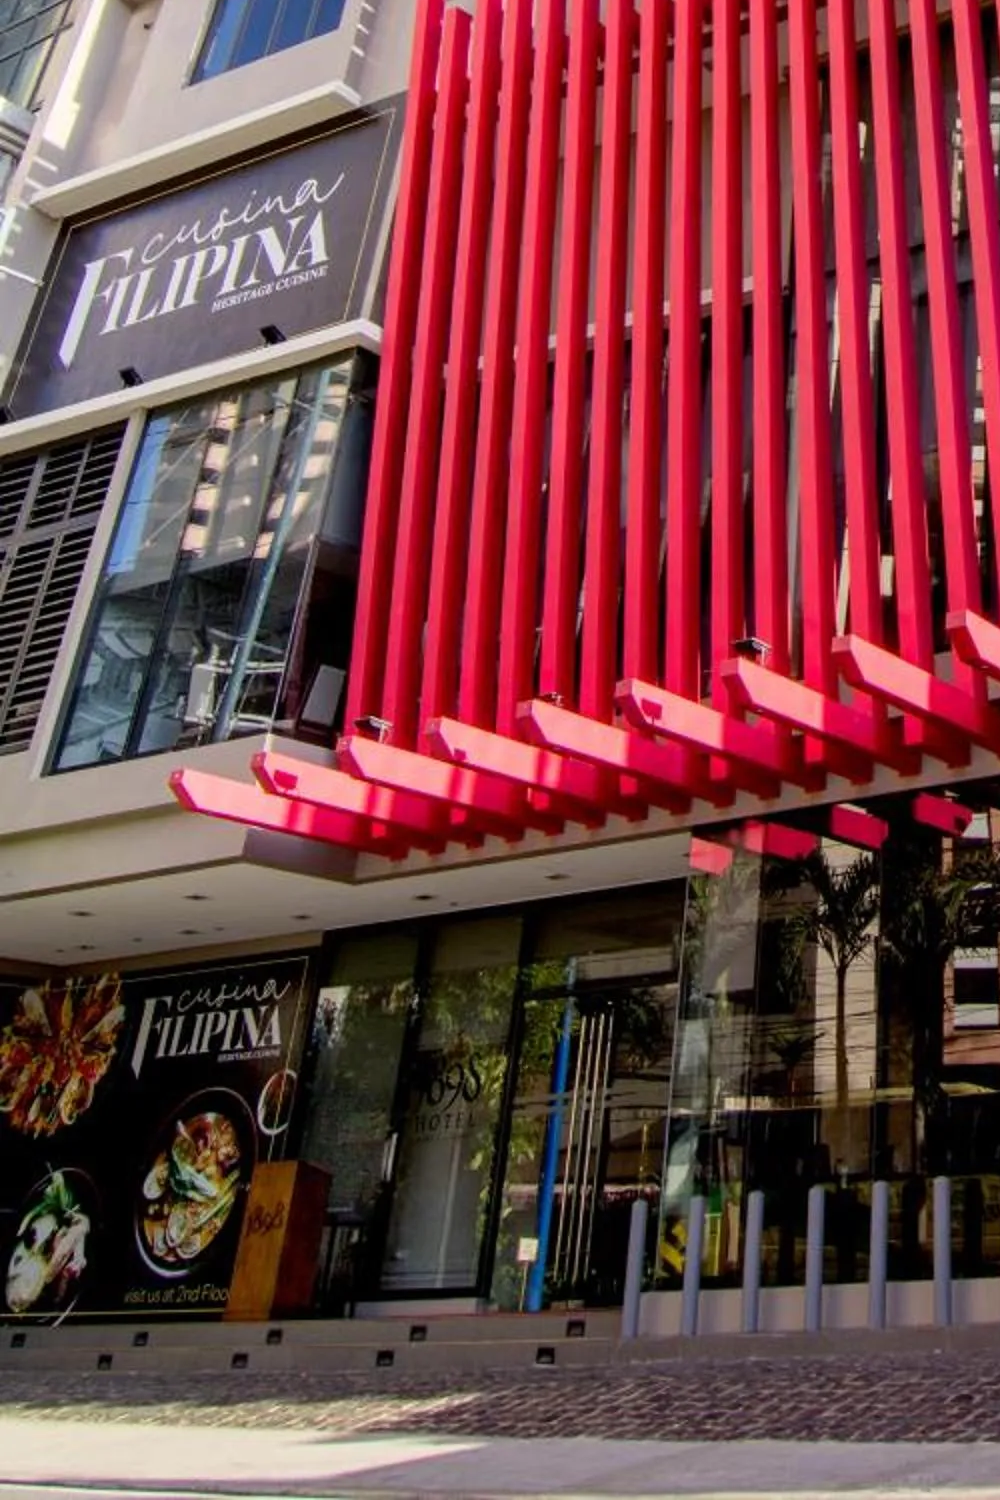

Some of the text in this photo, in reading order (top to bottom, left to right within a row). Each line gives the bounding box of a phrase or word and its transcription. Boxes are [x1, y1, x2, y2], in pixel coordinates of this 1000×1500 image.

[141, 171, 345, 265] cusina
[58, 209, 330, 372] FILIPINA
[211, 265, 329, 313] HERITAGE CUISINE
[131, 995, 282, 1080] FILIPINA
[176, 1284, 200, 1302] 2nd
[201, 1283, 231, 1301] Floo
